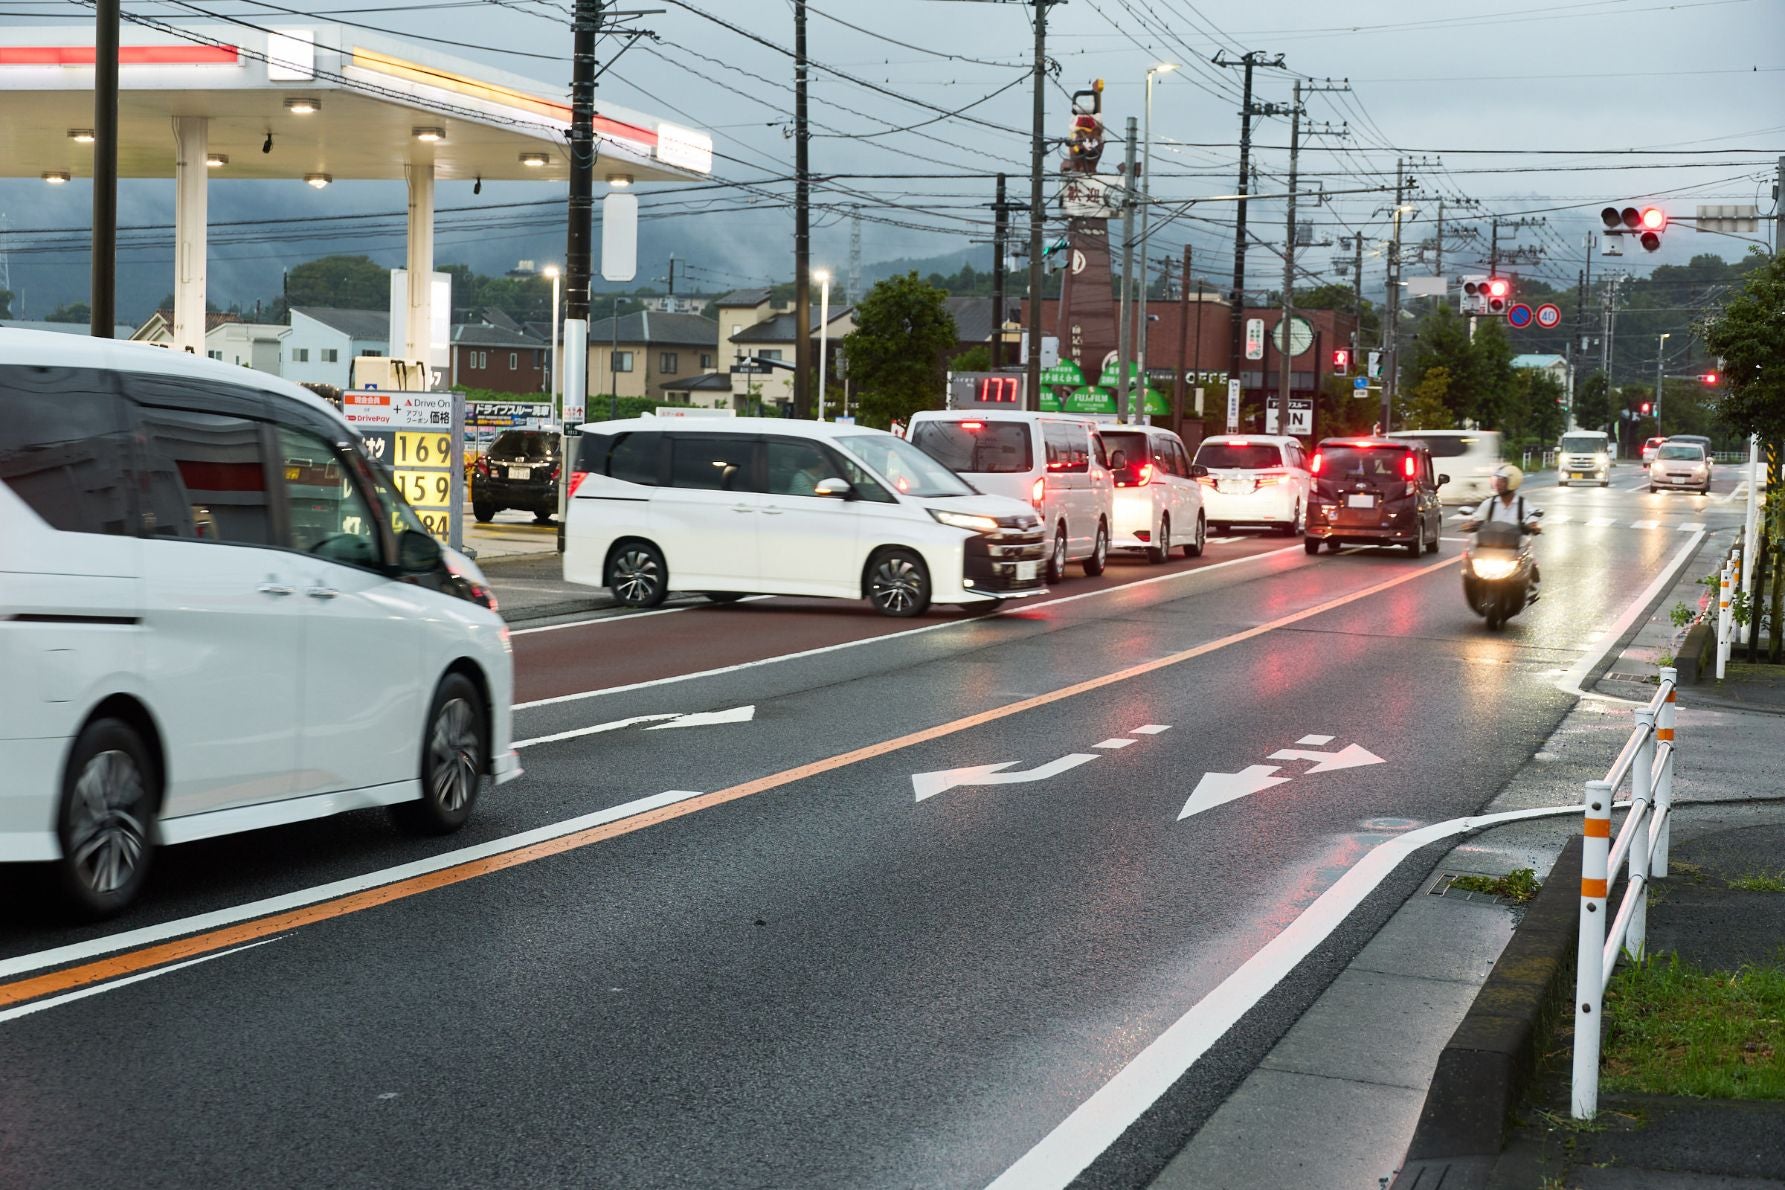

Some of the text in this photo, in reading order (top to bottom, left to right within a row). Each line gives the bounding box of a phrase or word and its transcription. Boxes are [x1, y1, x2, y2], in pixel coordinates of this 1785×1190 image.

[1541, 310, 1555, 321] 40
[982, 378, 1018, 402] 177
[414, 399, 451, 408] Drive On
[357, 415, 390, 423] DrivePay
[430, 411, 450, 424] 価格
[399, 435, 451, 464] 169
[399, 475, 449, 503] 159
